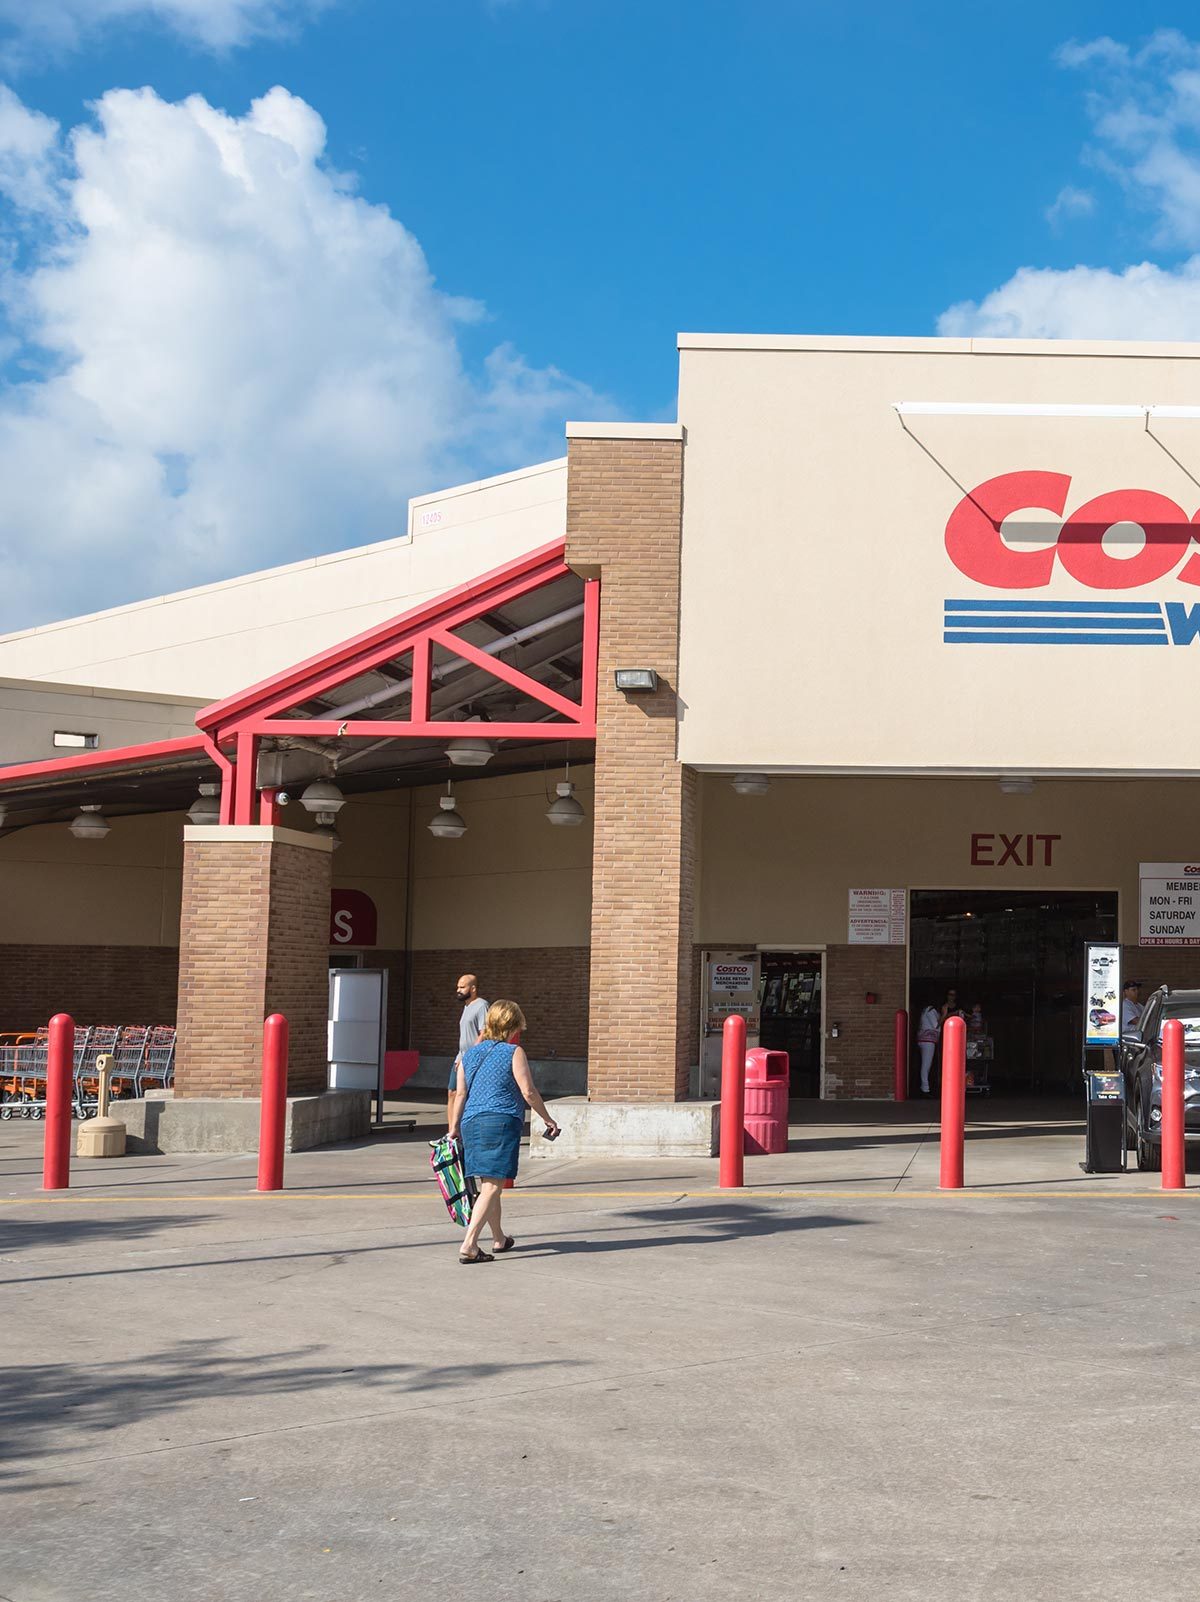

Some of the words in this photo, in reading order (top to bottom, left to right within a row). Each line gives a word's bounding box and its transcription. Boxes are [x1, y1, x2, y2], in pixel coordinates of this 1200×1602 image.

[971, 834, 1062, 866] EXIT
[1149, 896, 1170, 905] MON
[1178, 896, 1192, 905] FRI
[1149, 911, 1196, 920] SATURDAY
[1149, 925, 1185, 934] SUNDAY
